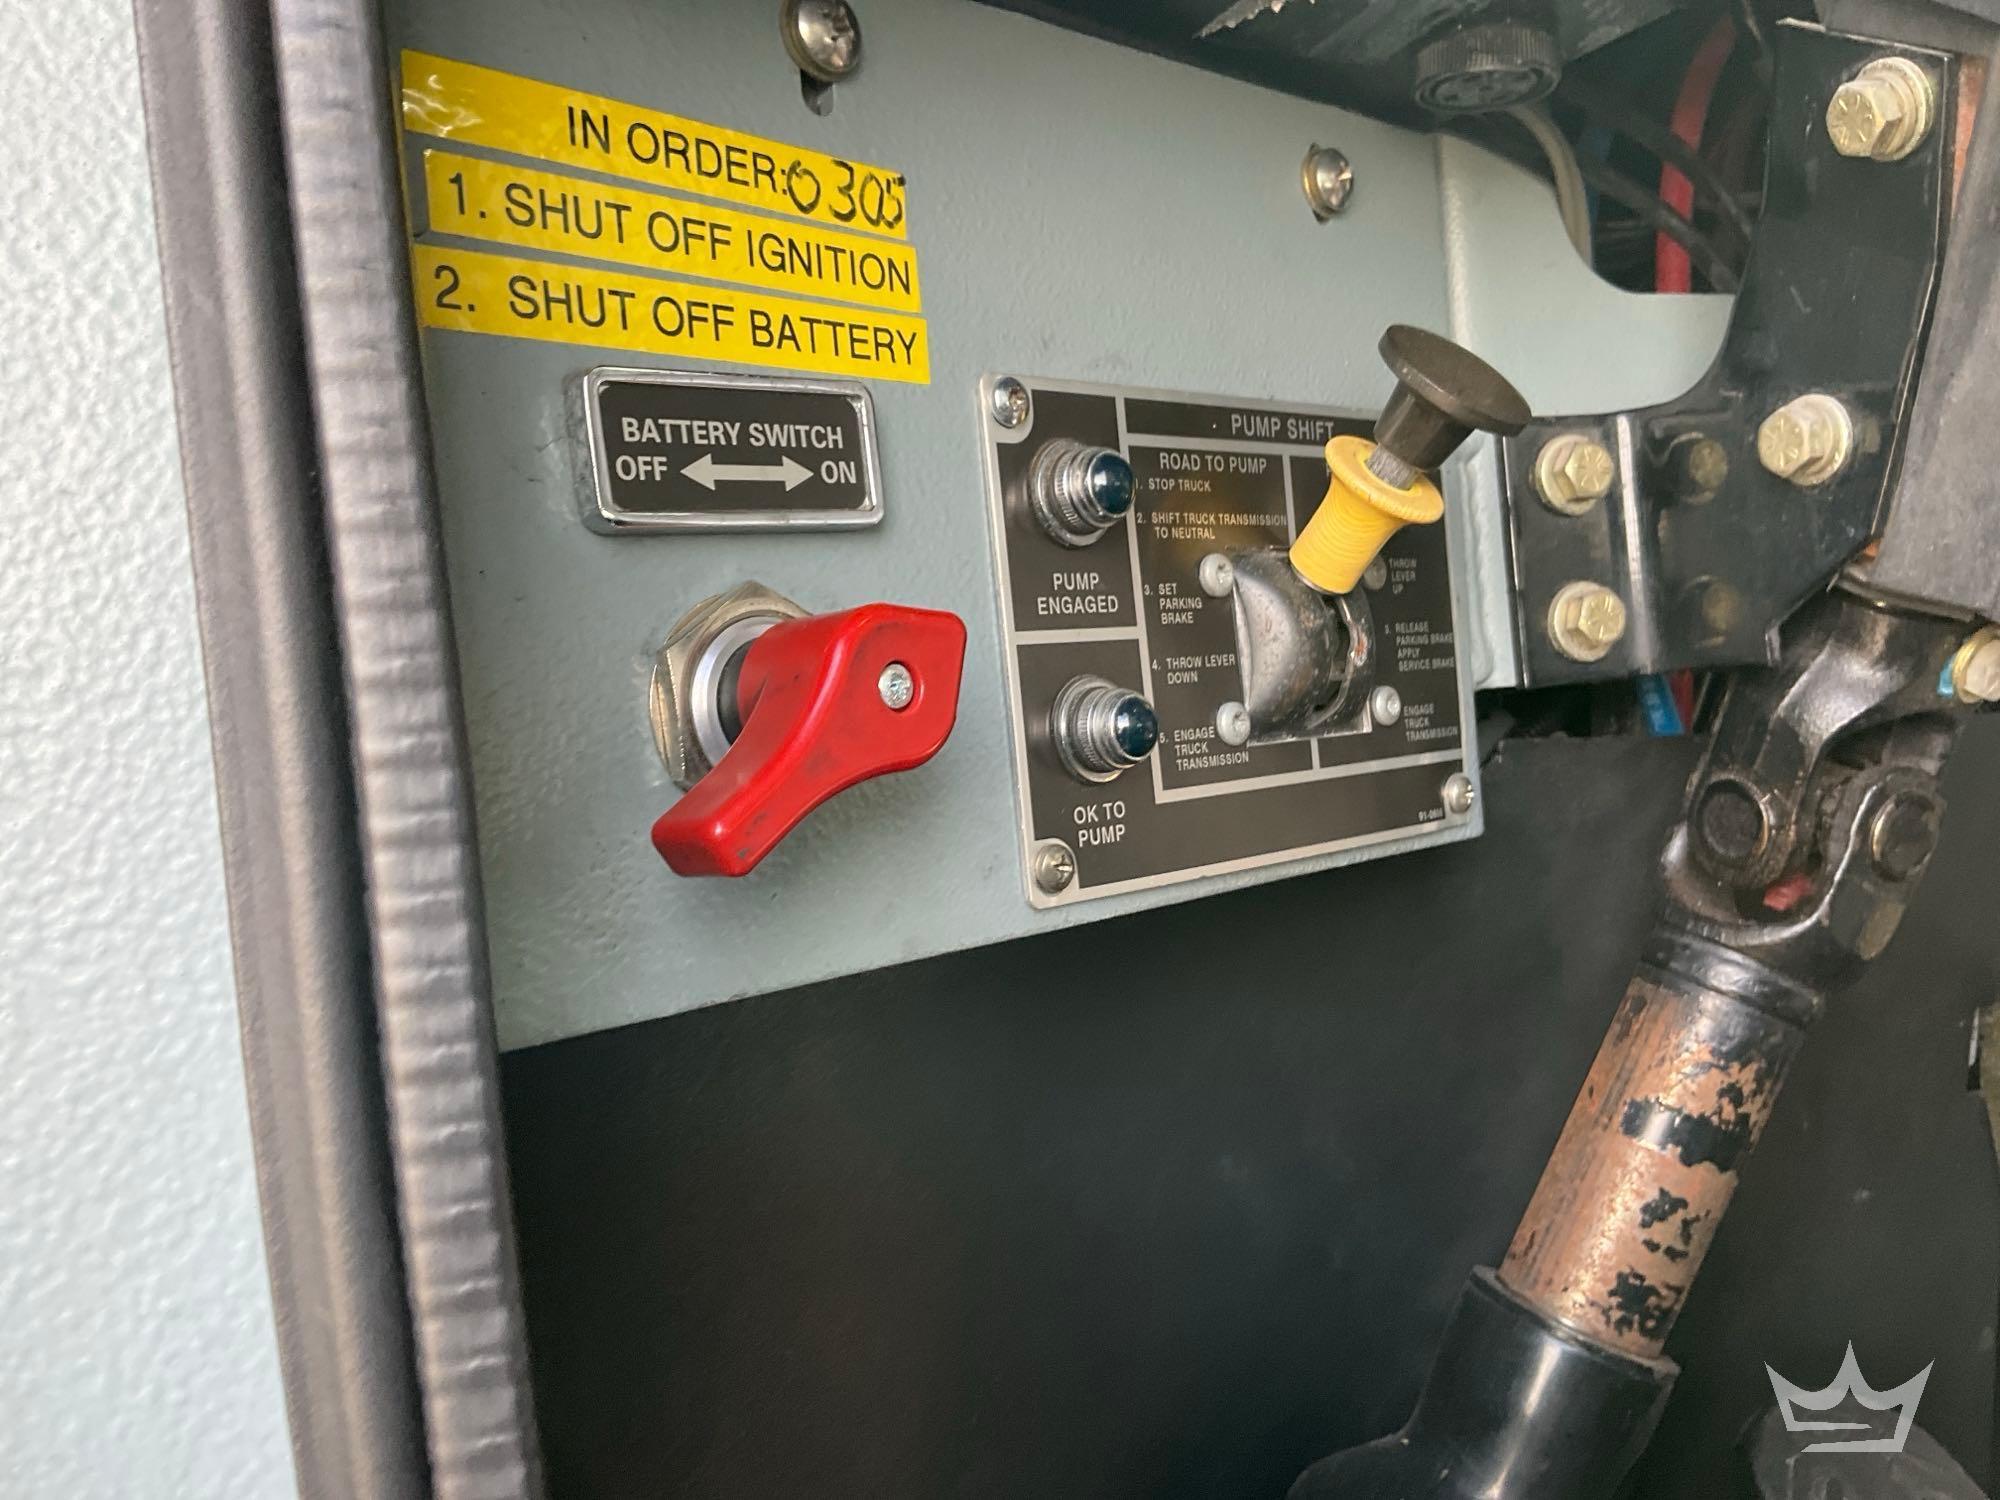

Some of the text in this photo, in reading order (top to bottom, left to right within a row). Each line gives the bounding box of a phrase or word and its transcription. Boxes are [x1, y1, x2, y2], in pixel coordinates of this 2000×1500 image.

[567, 106, 787, 195] IN ORDER:
[448, 172, 910, 295] 1. SHUT OFF IGNITION
[434, 265, 917, 365] 2. SHUT OFF BATTERY
[621, 417, 843, 449] BATTERY SWITCH
[1231, 414, 1334, 441] PUMP SHIFT
[615, 455, 856, 484] OFF ON
[1160, 452, 1266, 474] ROAD TO PUMP
[1149, 478, 1175, 490] STOP
[1179, 479, 1211, 492] TRUCK
[1137, 512, 1287, 526] 2. SHIFT TRUCK TRANSMISSION
[1155, 527, 1215, 539] TO NEUTRAL
[1053, 572, 1099, 590] PUMP
[1144, 583, 1177, 595] 3. SET
[1037, 595, 1118, 615] ENGAGED
[1159, 597, 1202, 610] PARKING
[1161, 612, 1194, 625] BRAKE
[1152, 654, 1235, 670] 4. THROW LEVER
[1167, 670, 1198, 684] DOWN
[1174, 726, 1215, 742] ENGAGE
[1175, 742, 1208, 756] TRUCK
[1176, 751, 1249, 771] TRANSMISSION
[1073, 801, 1125, 824] OK TO
[1078, 824, 1125, 847] PUMP
